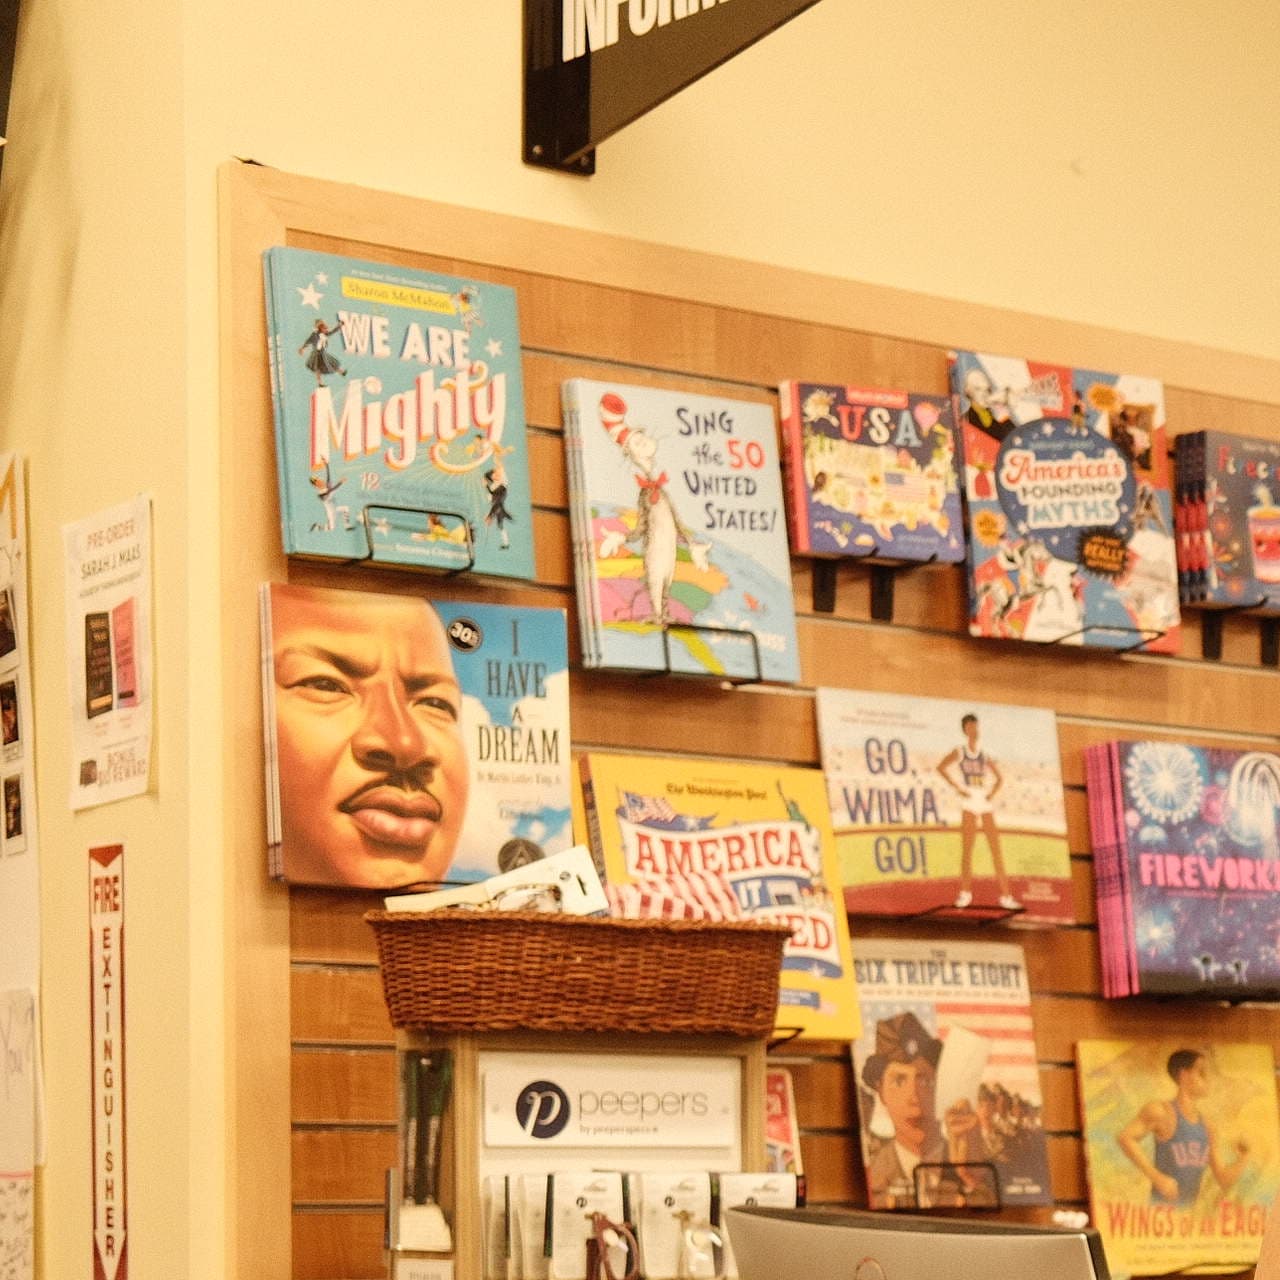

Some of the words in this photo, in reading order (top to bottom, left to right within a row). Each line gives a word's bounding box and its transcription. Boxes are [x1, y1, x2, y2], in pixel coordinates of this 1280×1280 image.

[337, 310, 392, 358] WE
[401, 321, 472, 369] ARE
[309, 359, 508, 475] Mighty
[676, 406, 733, 436] SING
[691, 441, 724, 468] the
[726, 440, 766, 470] 50
[1005, 454, 1124, 485] America's
[683, 470, 758, 497] UNITED
[1030, 501, 1119, 523] MYTHS
[511, 619, 521, 656] I
[486, 658, 548, 699] HAVE
[511, 705, 524, 722] A
[477, 725, 560, 765] DREAM
[864, 737, 918, 778] GO,
[842, 786, 948, 828] WILMA,
[634, 829, 811, 879] AMERICA
[874, 833, 928, 877] GO!
[92, 875, 121, 914] FIRE
[891, 959, 963, 986] TRIPLE
[967, 961, 1022, 989] EIGHT
[102, 925, 116, 1261] EXTINGUISHER
[578, 1089, 709, 1122] peepers
[1102, 1201, 1176, 1239] WINGS
